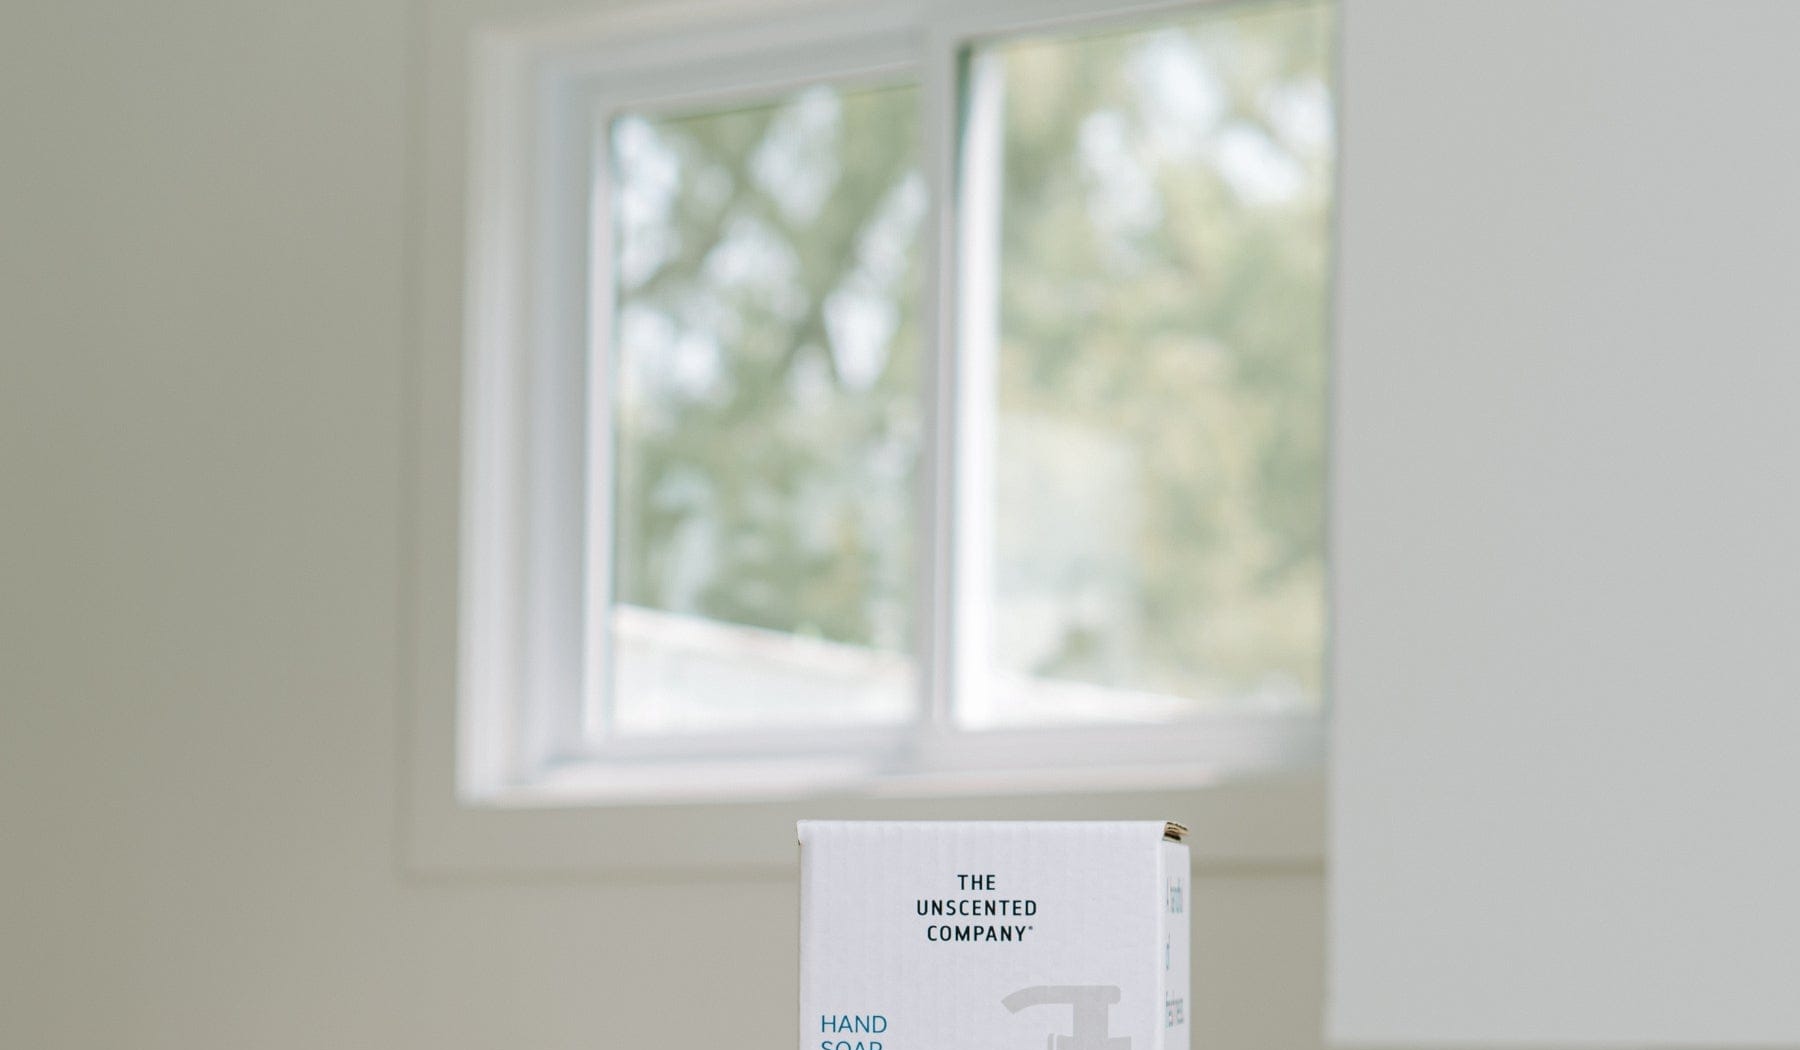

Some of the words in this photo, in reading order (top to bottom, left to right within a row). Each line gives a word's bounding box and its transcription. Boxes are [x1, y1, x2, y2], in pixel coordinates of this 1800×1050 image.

[957, 874, 995, 891] THE
[917, 899, 1037, 916] UNSCENTED
[821, 1015, 888, 1034] HAND
